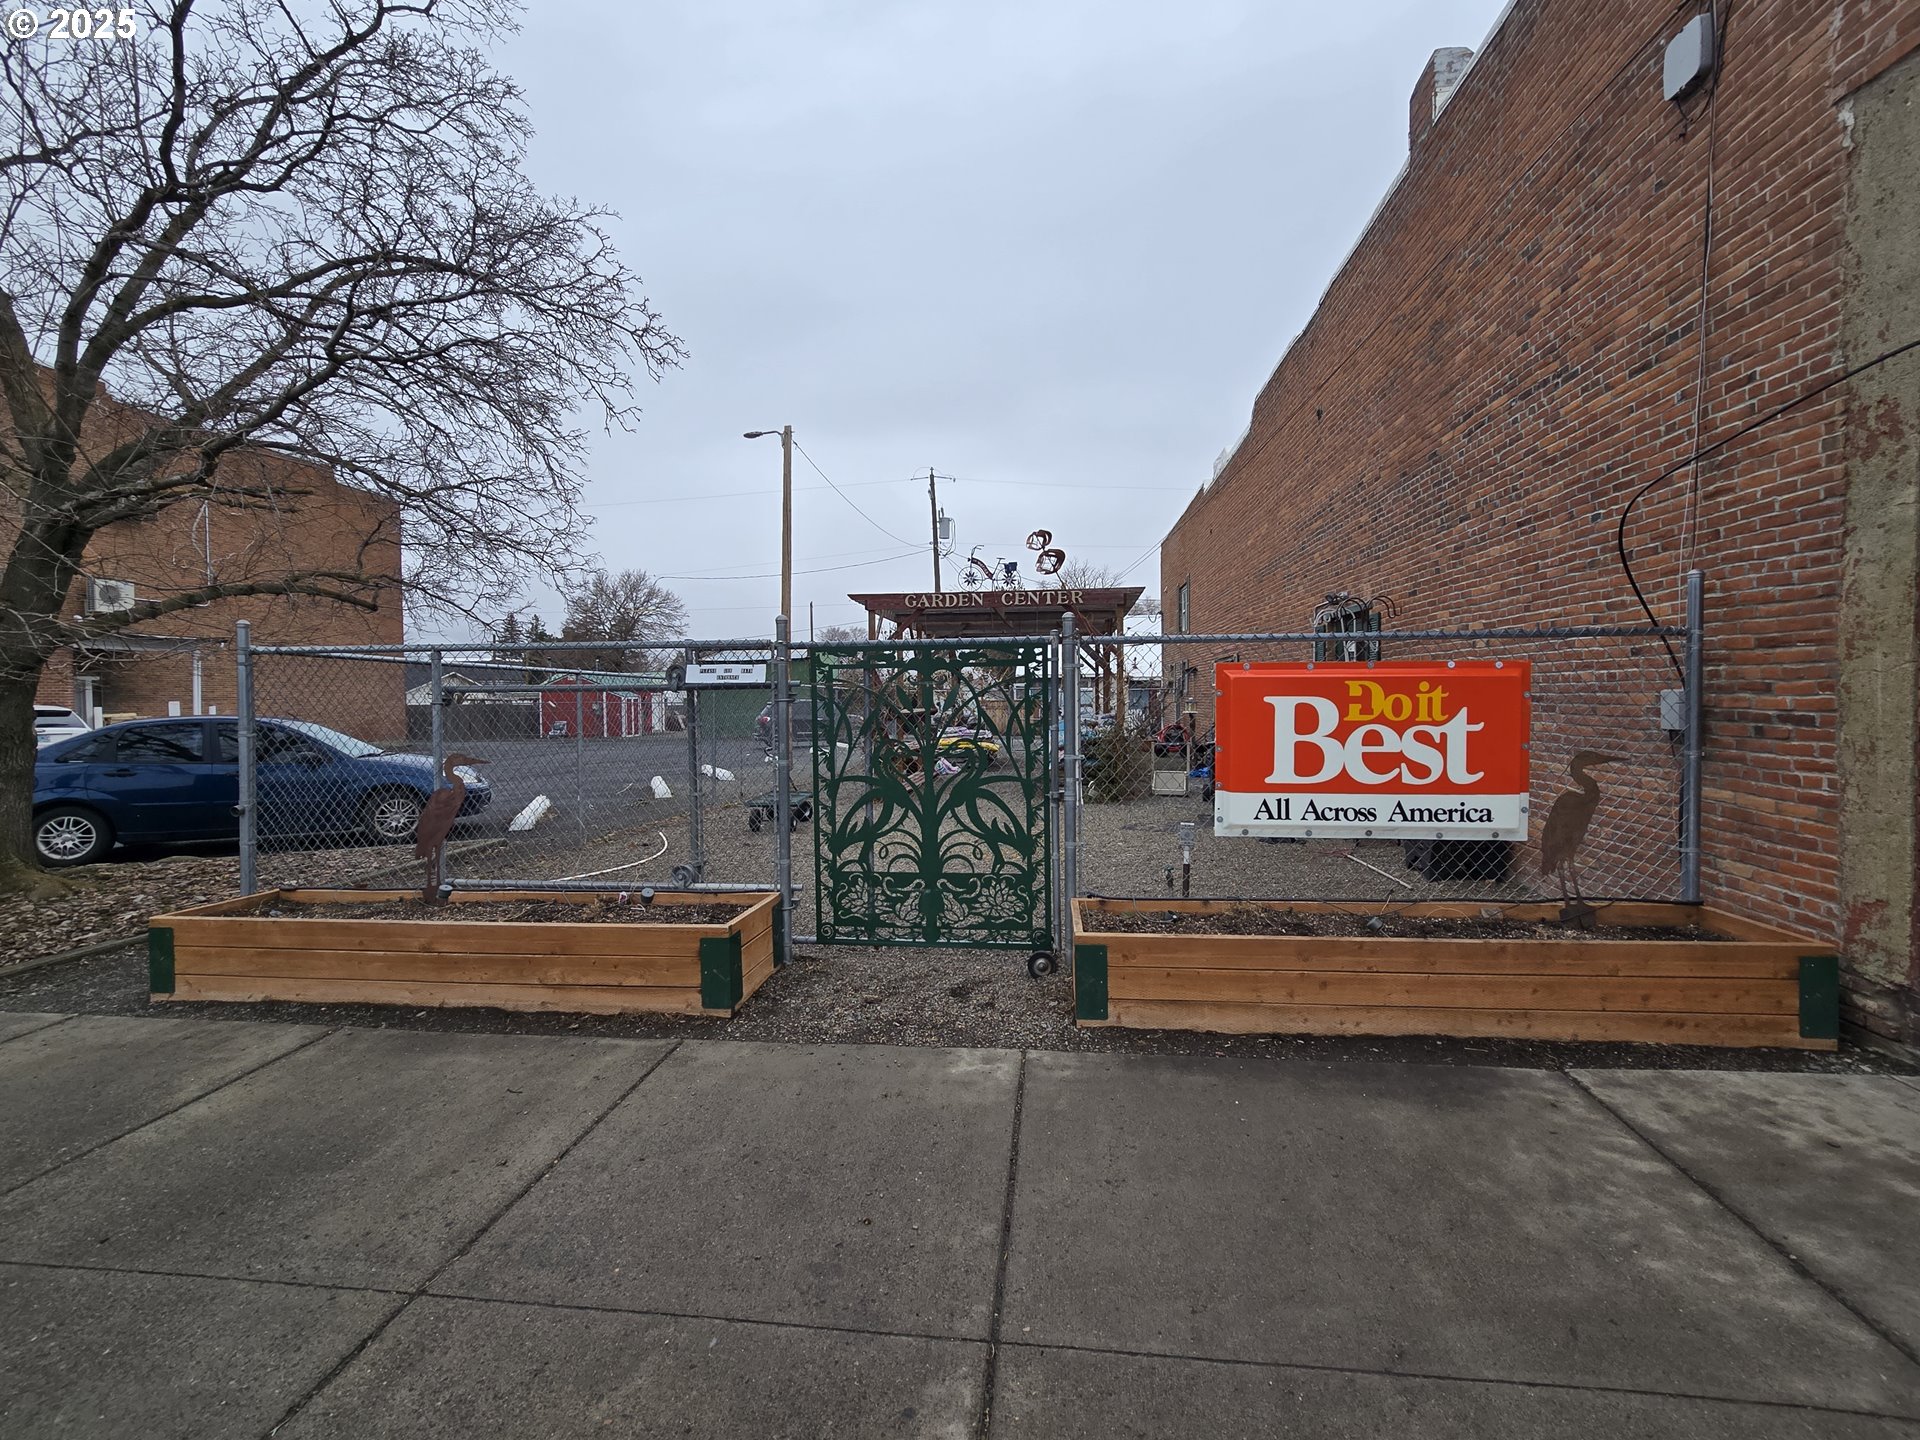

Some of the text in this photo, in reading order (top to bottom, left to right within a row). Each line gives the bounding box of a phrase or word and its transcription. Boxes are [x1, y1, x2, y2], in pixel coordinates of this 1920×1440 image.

[904, 590, 1084, 608] GARDEN CENTER
[1344, 680, 1449, 722] Do it
[1263, 695, 1485, 785] Best
[1253, 798, 1495, 824] All Across America
